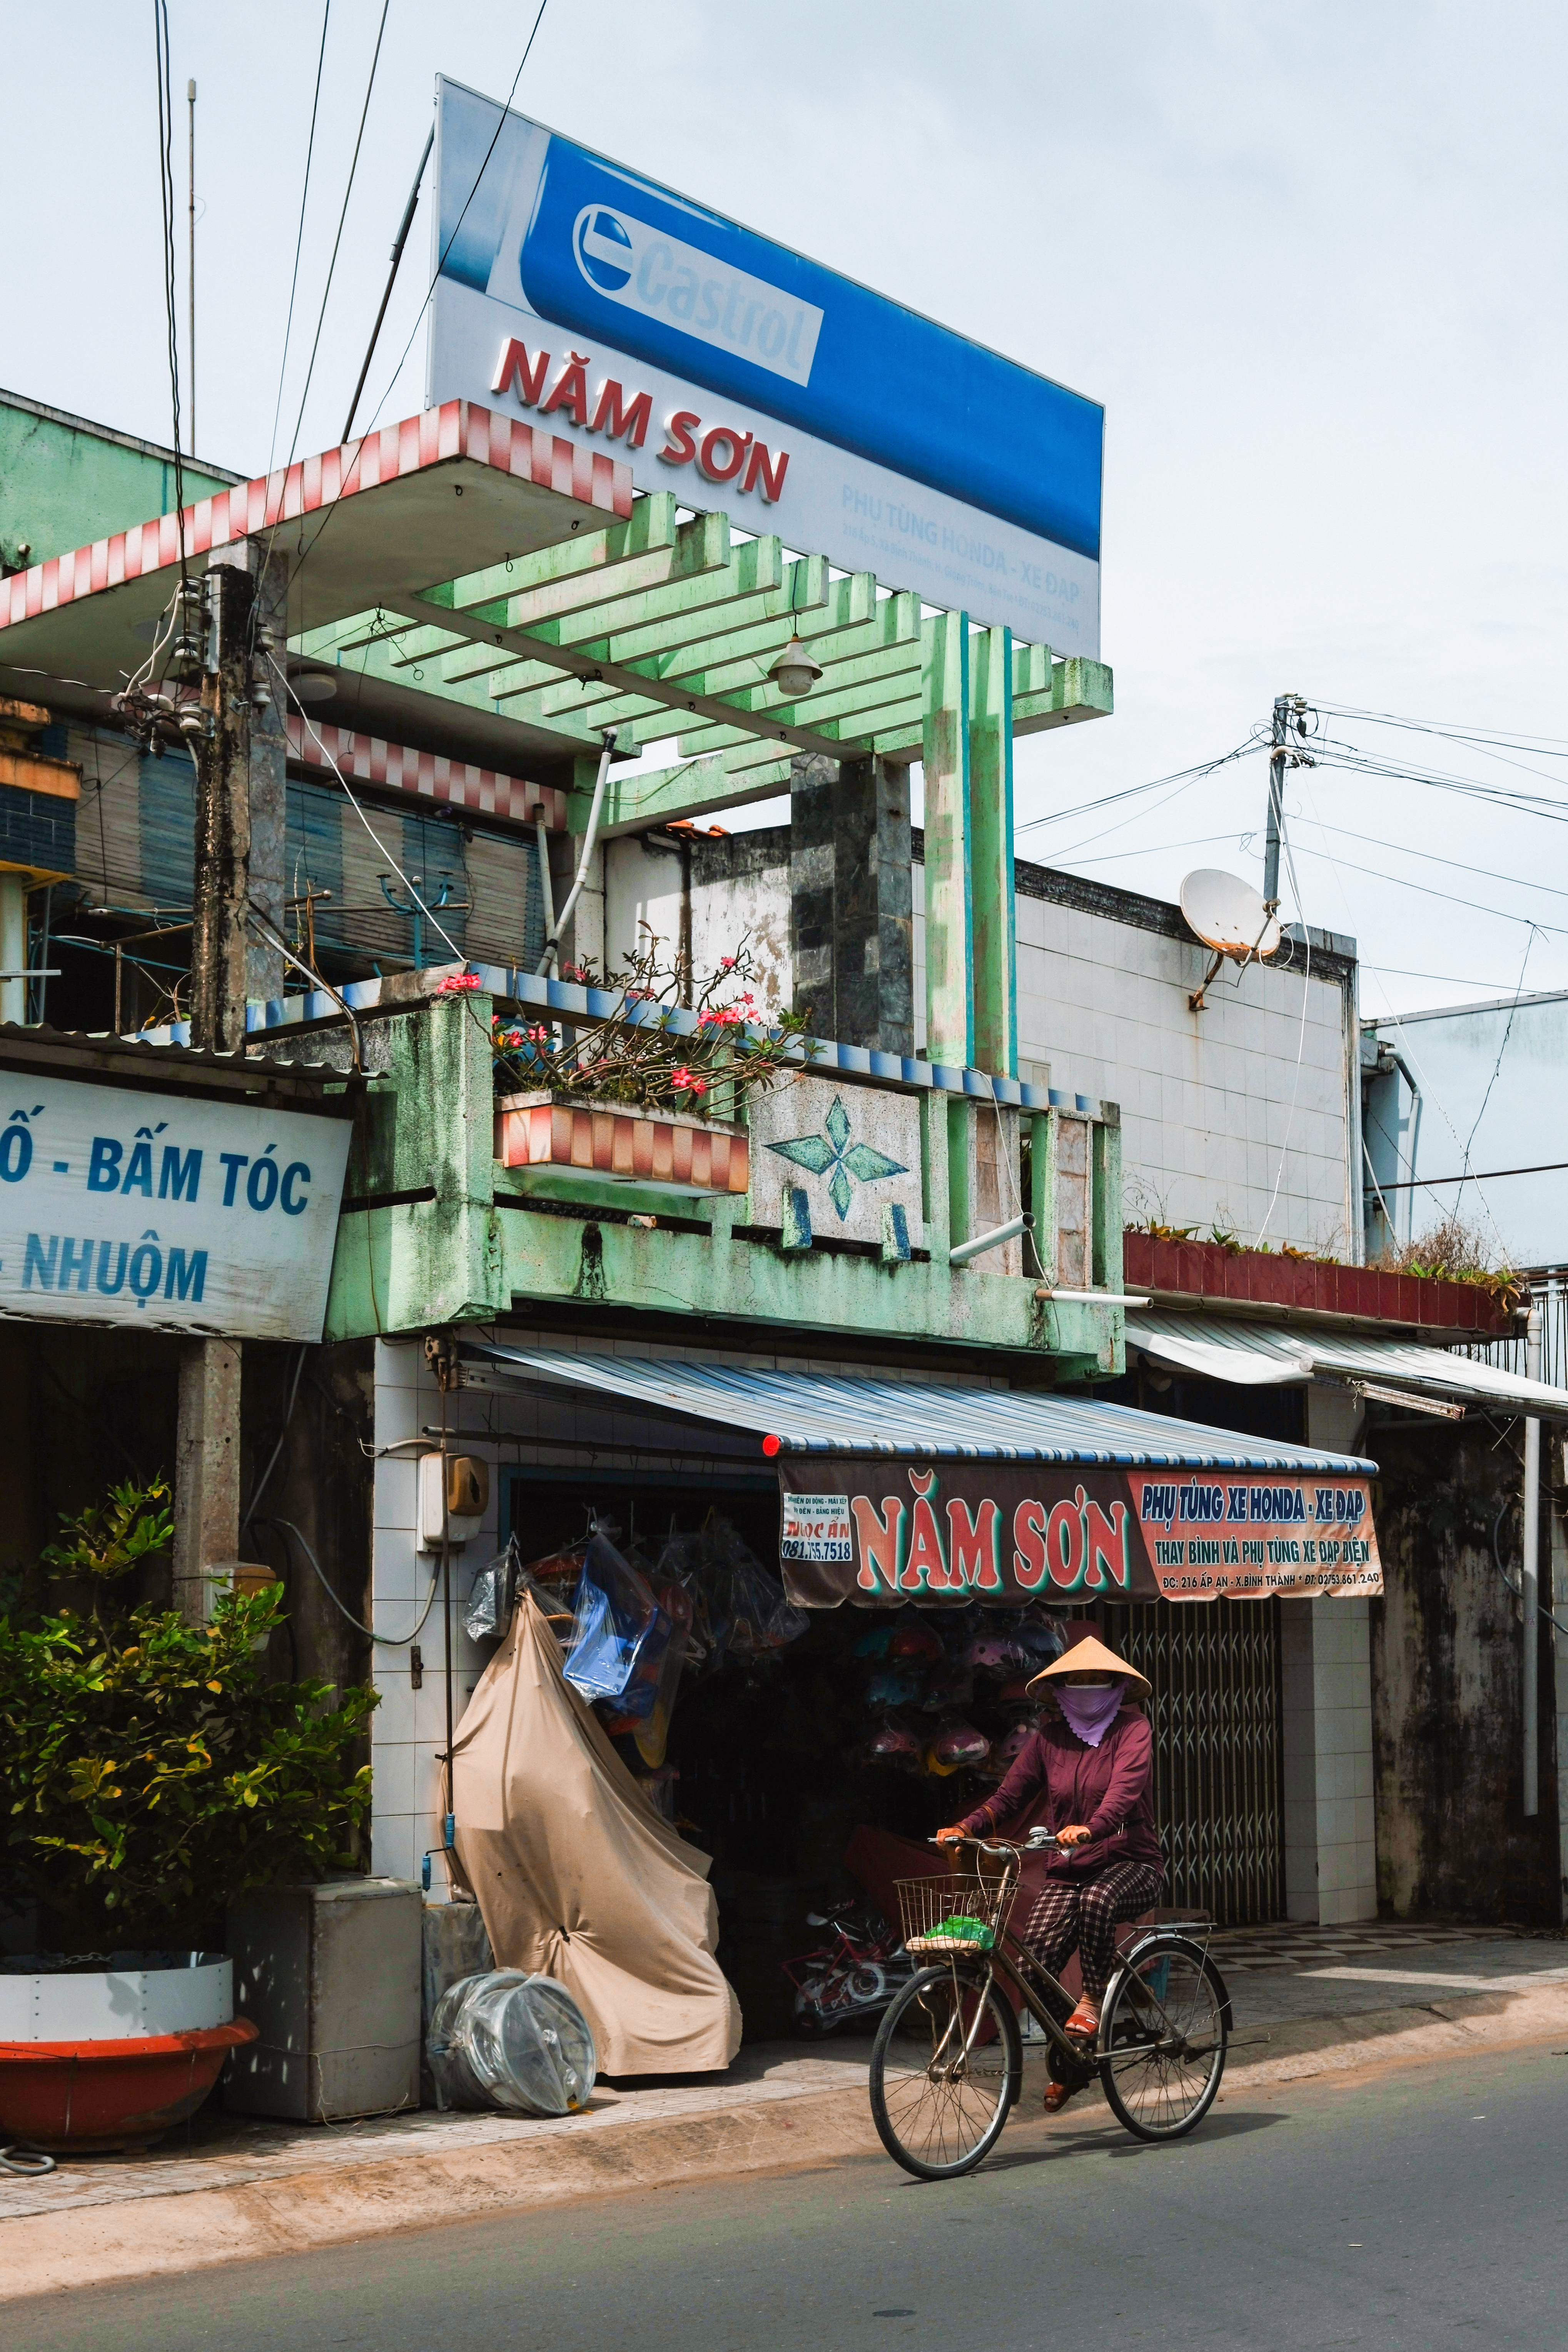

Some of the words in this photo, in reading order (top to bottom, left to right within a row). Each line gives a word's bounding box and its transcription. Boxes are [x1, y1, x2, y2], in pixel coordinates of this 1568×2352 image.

[637, 242, 804, 370] Castrol
[491, 337, 653, 449] NĂM
[656, 411, 790, 502] SƠN
[843, 484, 882, 527] PHỤ
[886, 501, 937, 546] TÙNG
[942, 526, 1007, 575] HONDA
[1021, 561, 1041, 589] XE
[1045, 571, 1080, 606] ĐẠP
[87, 1122, 203, 1203] BẤM
[220, 1144, 311, 1215] TÓC
[22, 1230, 208, 1309] NHUỘM
[799, 1506, 811, 1514] ĐÈN
[831, 1507, 844, 1515] HIỆU
[812, 1497, 824, 1505] ĐỘNG
[851, 1467, 1001, 1593] NĂM
[1014, 1484, 1129, 1592] SƠN
[1141, 1484, 1177, 1532] PHỤ
[1179, 1476, 1224, 1522] TÙNG
[1226, 1486, 1247, 1522] XE
[1249, 1486, 1306, 1522] HONDA
[1314, 1488, 1334, 1522] XE
[1334, 1488, 1365, 1532] ĐẠP
[782, 1540, 850, 1560] 081.755.7518
[1154, 1540, 1185, 1565] THAY
[1188, 1535, 1220, 1565] BÌNH
[1222, 1535, 1239, 1564] VÀ
[1241, 1539, 1265, 1569] PHỤ
[1266, 1535, 1300, 1564] TÙNG
[1302, 1539, 1316, 1564] XE
[1318, 1539, 1340, 1567] ĐẠP
[1163, 1576, 1178, 1589] ĐC:
[1181, 1576, 1197, 1588] 216
[1200, 1571, 1212, 1588] ẤP
[1215, 1576, 1228, 1587] AN
[1235, 1573, 1262, 1587] X.BÌNH
[1266, 1572, 1295, 1586] THÀNH
[1304, 1574, 1316, 1586] ĐT:
[1318, 1572, 1379, 1586] 02753.861.240
